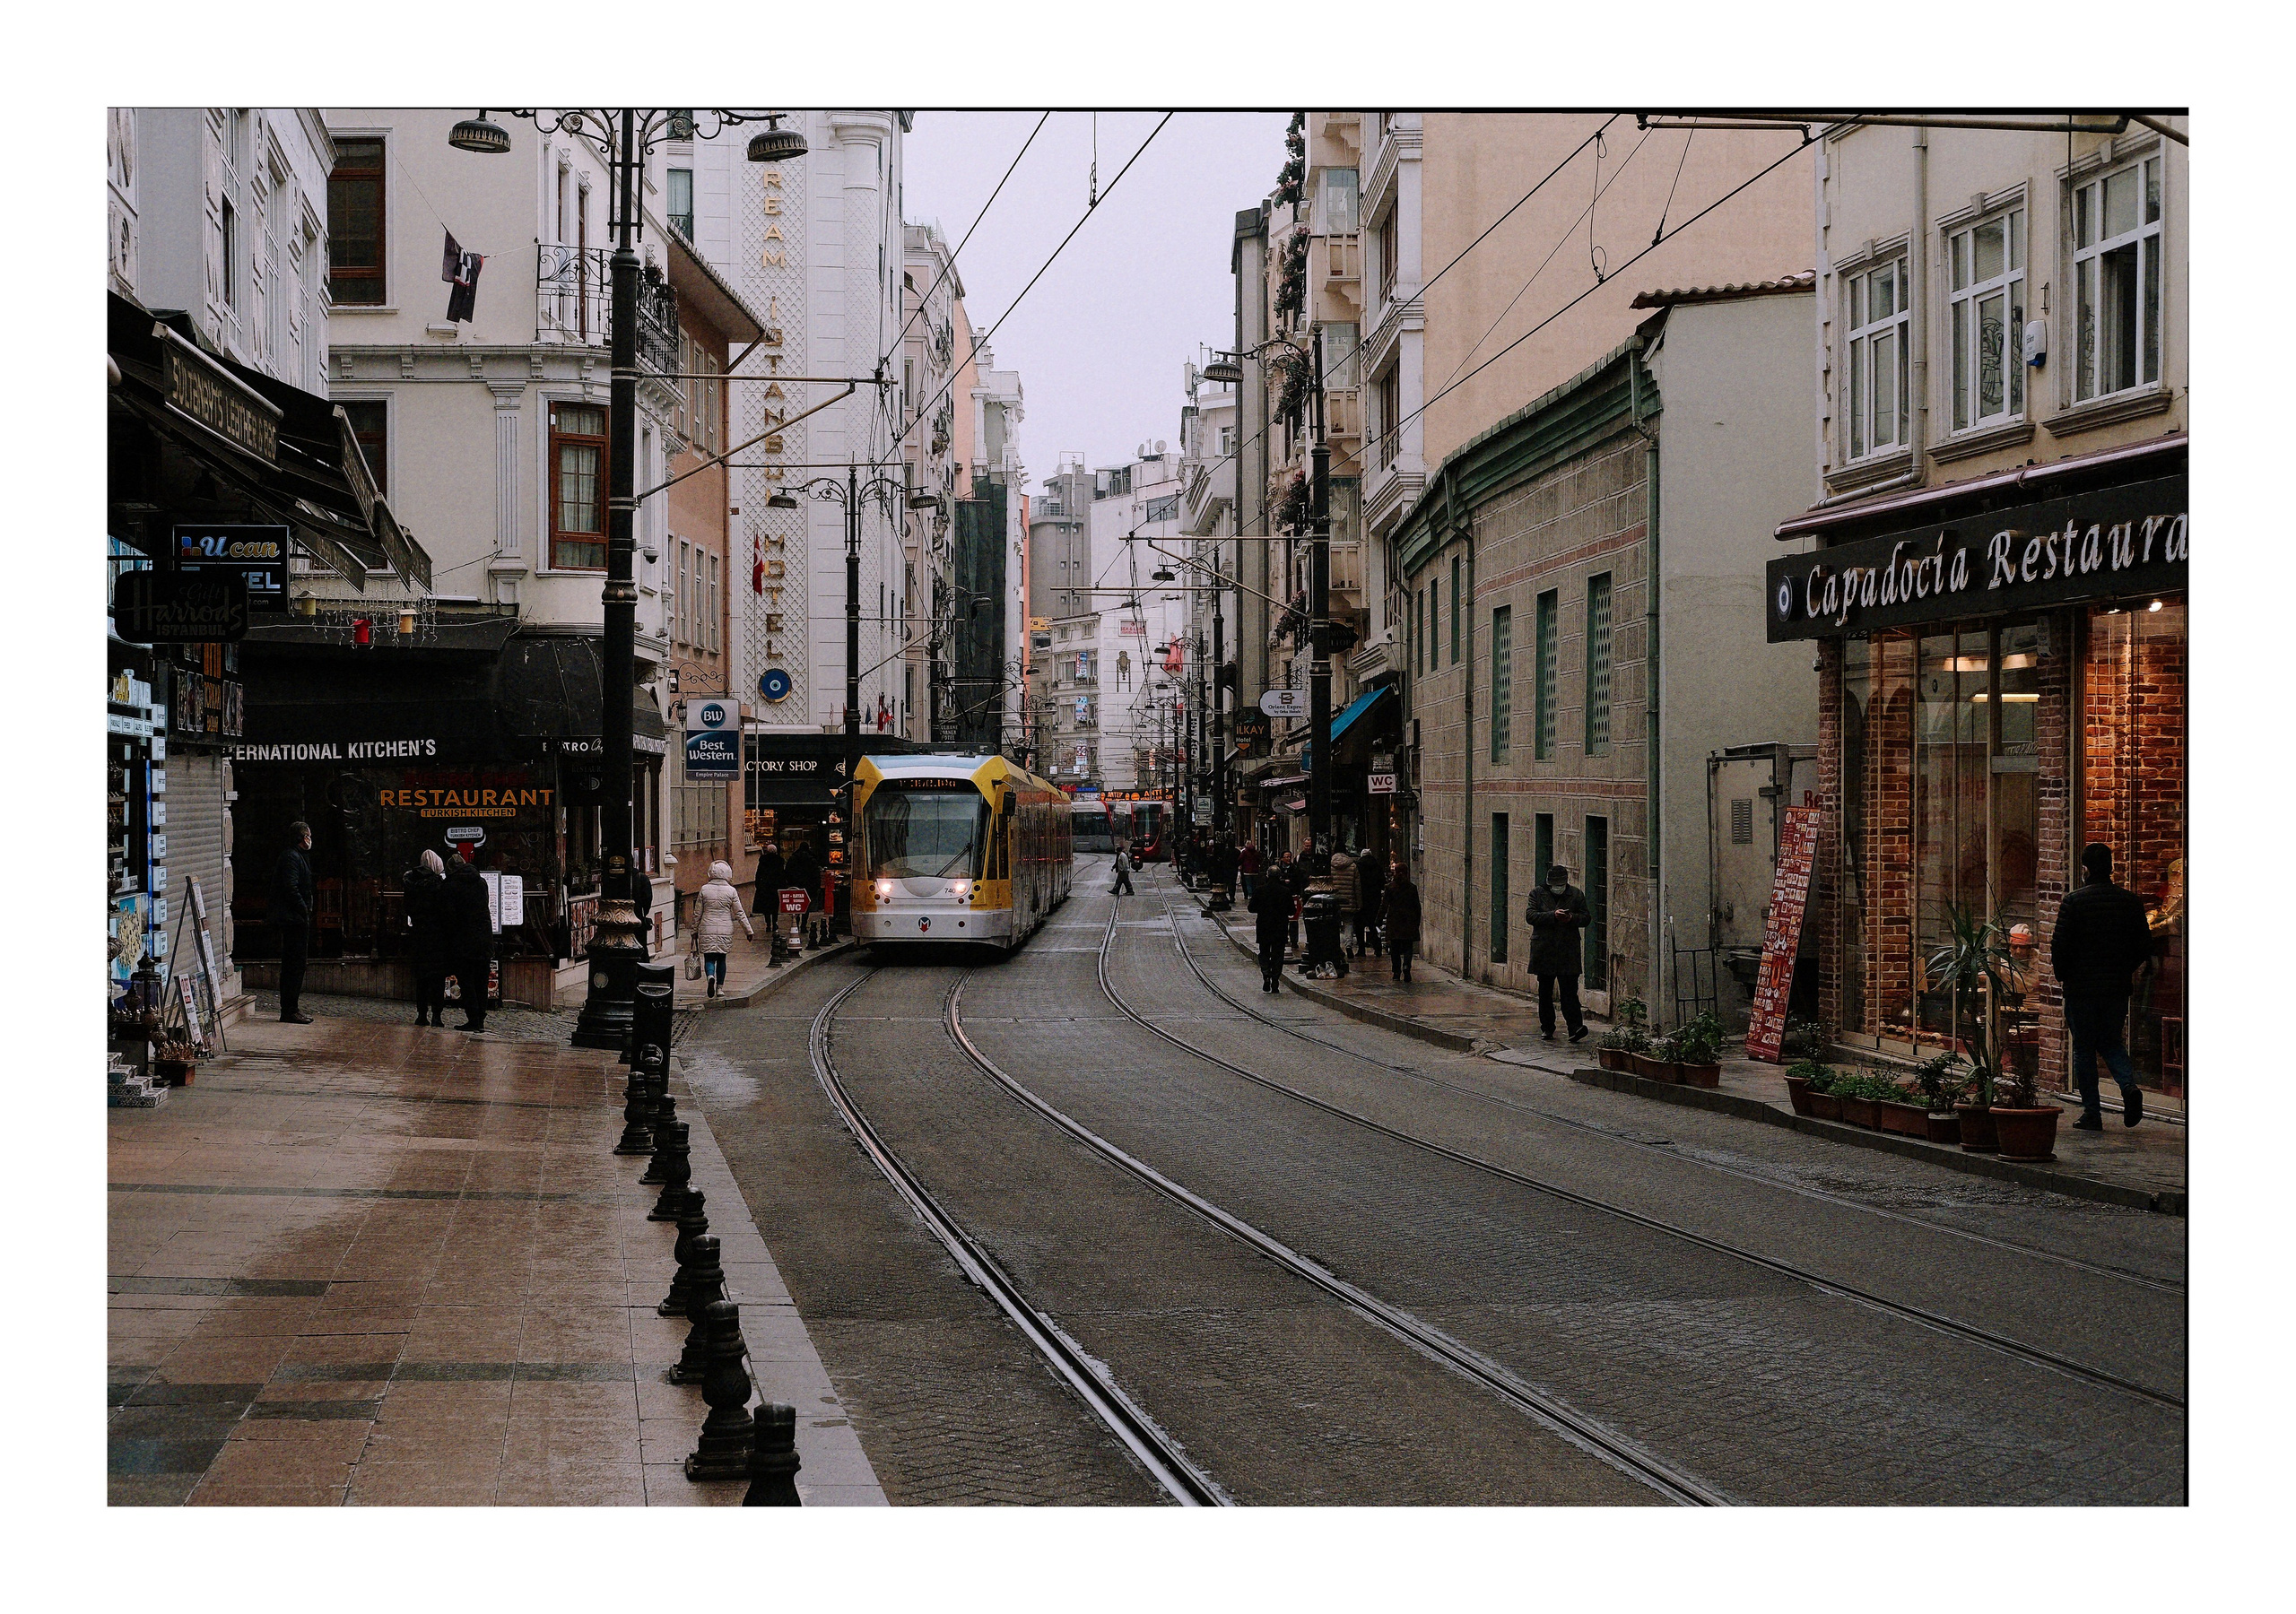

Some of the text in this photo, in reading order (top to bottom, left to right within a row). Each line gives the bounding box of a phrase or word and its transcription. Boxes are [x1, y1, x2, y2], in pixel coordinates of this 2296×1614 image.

[763, 170, 786, 268] REAM
[179, 583, 222, 602] Gift
[764, 534, 786, 657] HOTEL
[119, 577, 243, 631] Harrods
[156, 625, 226, 636] ISTANBUL
[703, 710, 723, 722] BW
[236, 739, 437, 760] ERNATIONAL KITCHEN'S
[700, 740, 725, 751] Best
[744, 761, 818, 772] CTORY SHOP
[1371, 777, 1393, 786] WC
[380, 789, 555, 806] RESTAURANT
[422, 808, 514, 817] TURKISH KITCHEN
